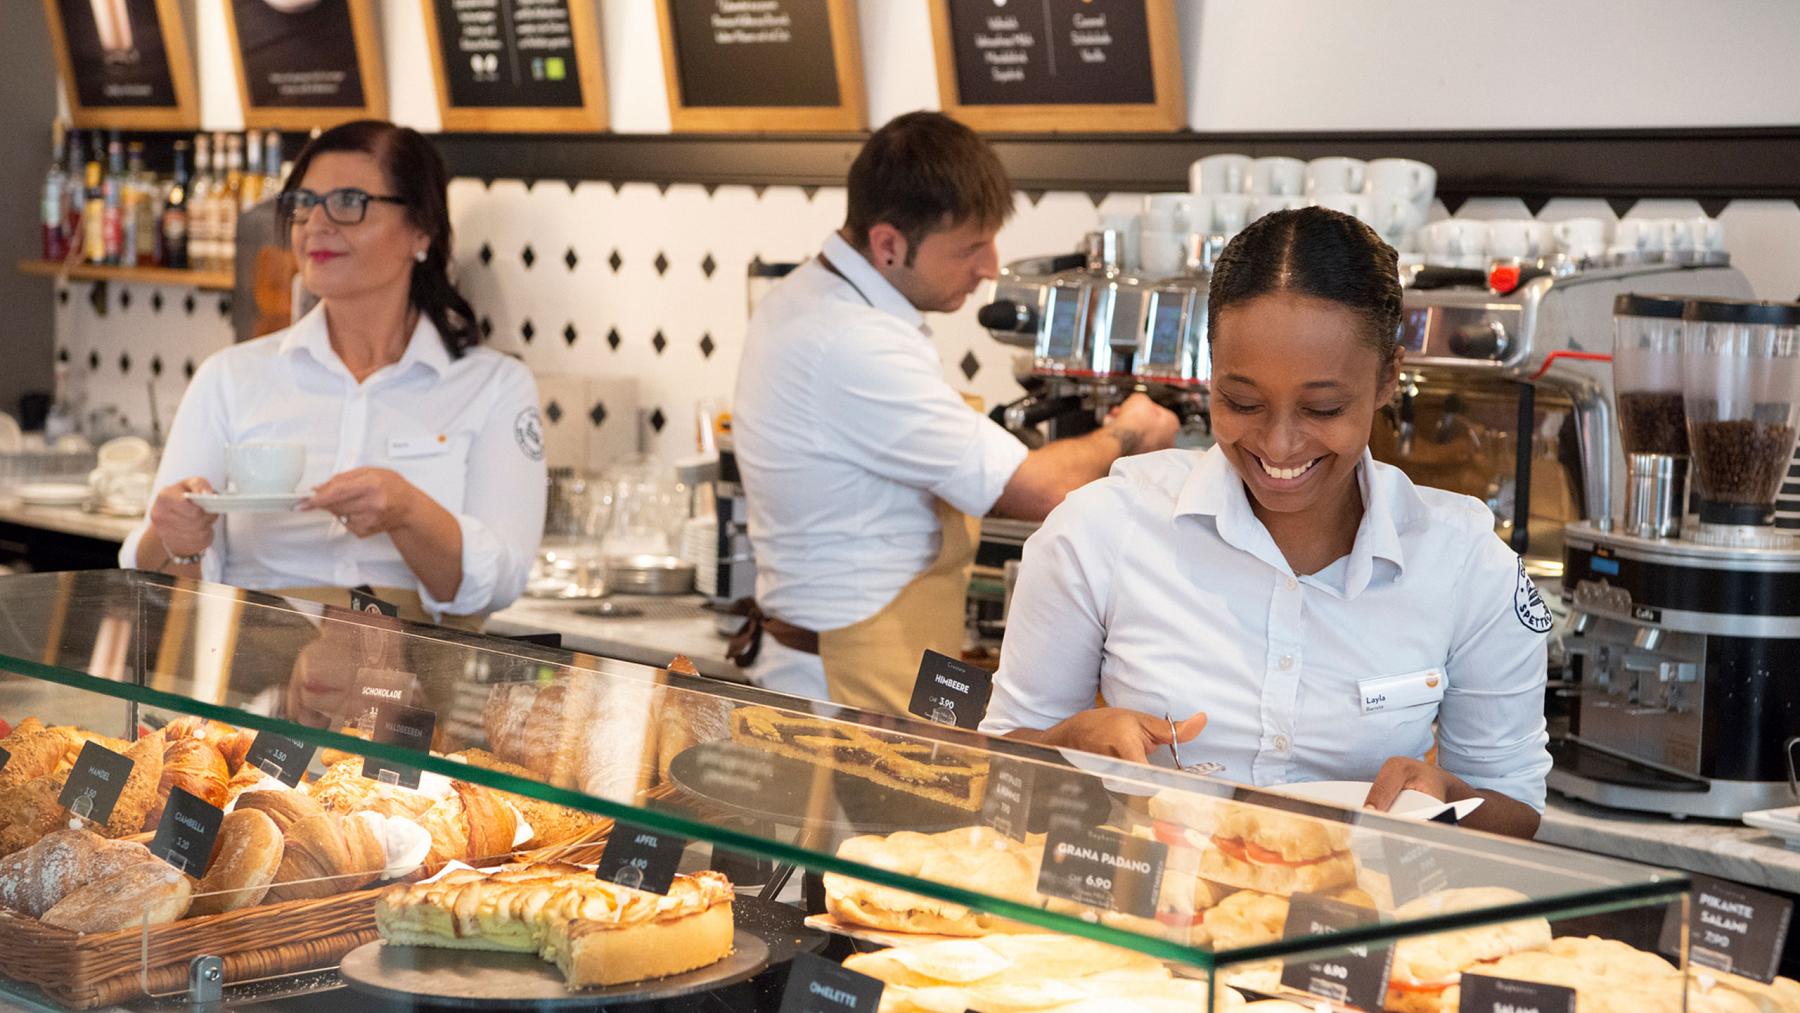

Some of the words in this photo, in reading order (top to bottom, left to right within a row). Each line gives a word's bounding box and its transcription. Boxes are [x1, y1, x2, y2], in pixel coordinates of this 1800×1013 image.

[935, 673, 970, 694] HIMBEERE
[362, 686, 403, 699] SCHOKOLADE
[1366, 694, 1386, 704] Layla
[938, 696, 955, 710] 3.90
[634, 834, 658, 848] APFEL
[1057, 842, 1099, 862] GRANA
[1101, 852, 1151, 874] PADANO
[1086, 874, 1112, 890] 6.90
[1699, 893, 1754, 918] PIKANTE
[1701, 911, 1748, 934] SALAMI
[1323, 962, 1348, 979] 6.90
[809, 980, 858, 1008] OMELETTE
